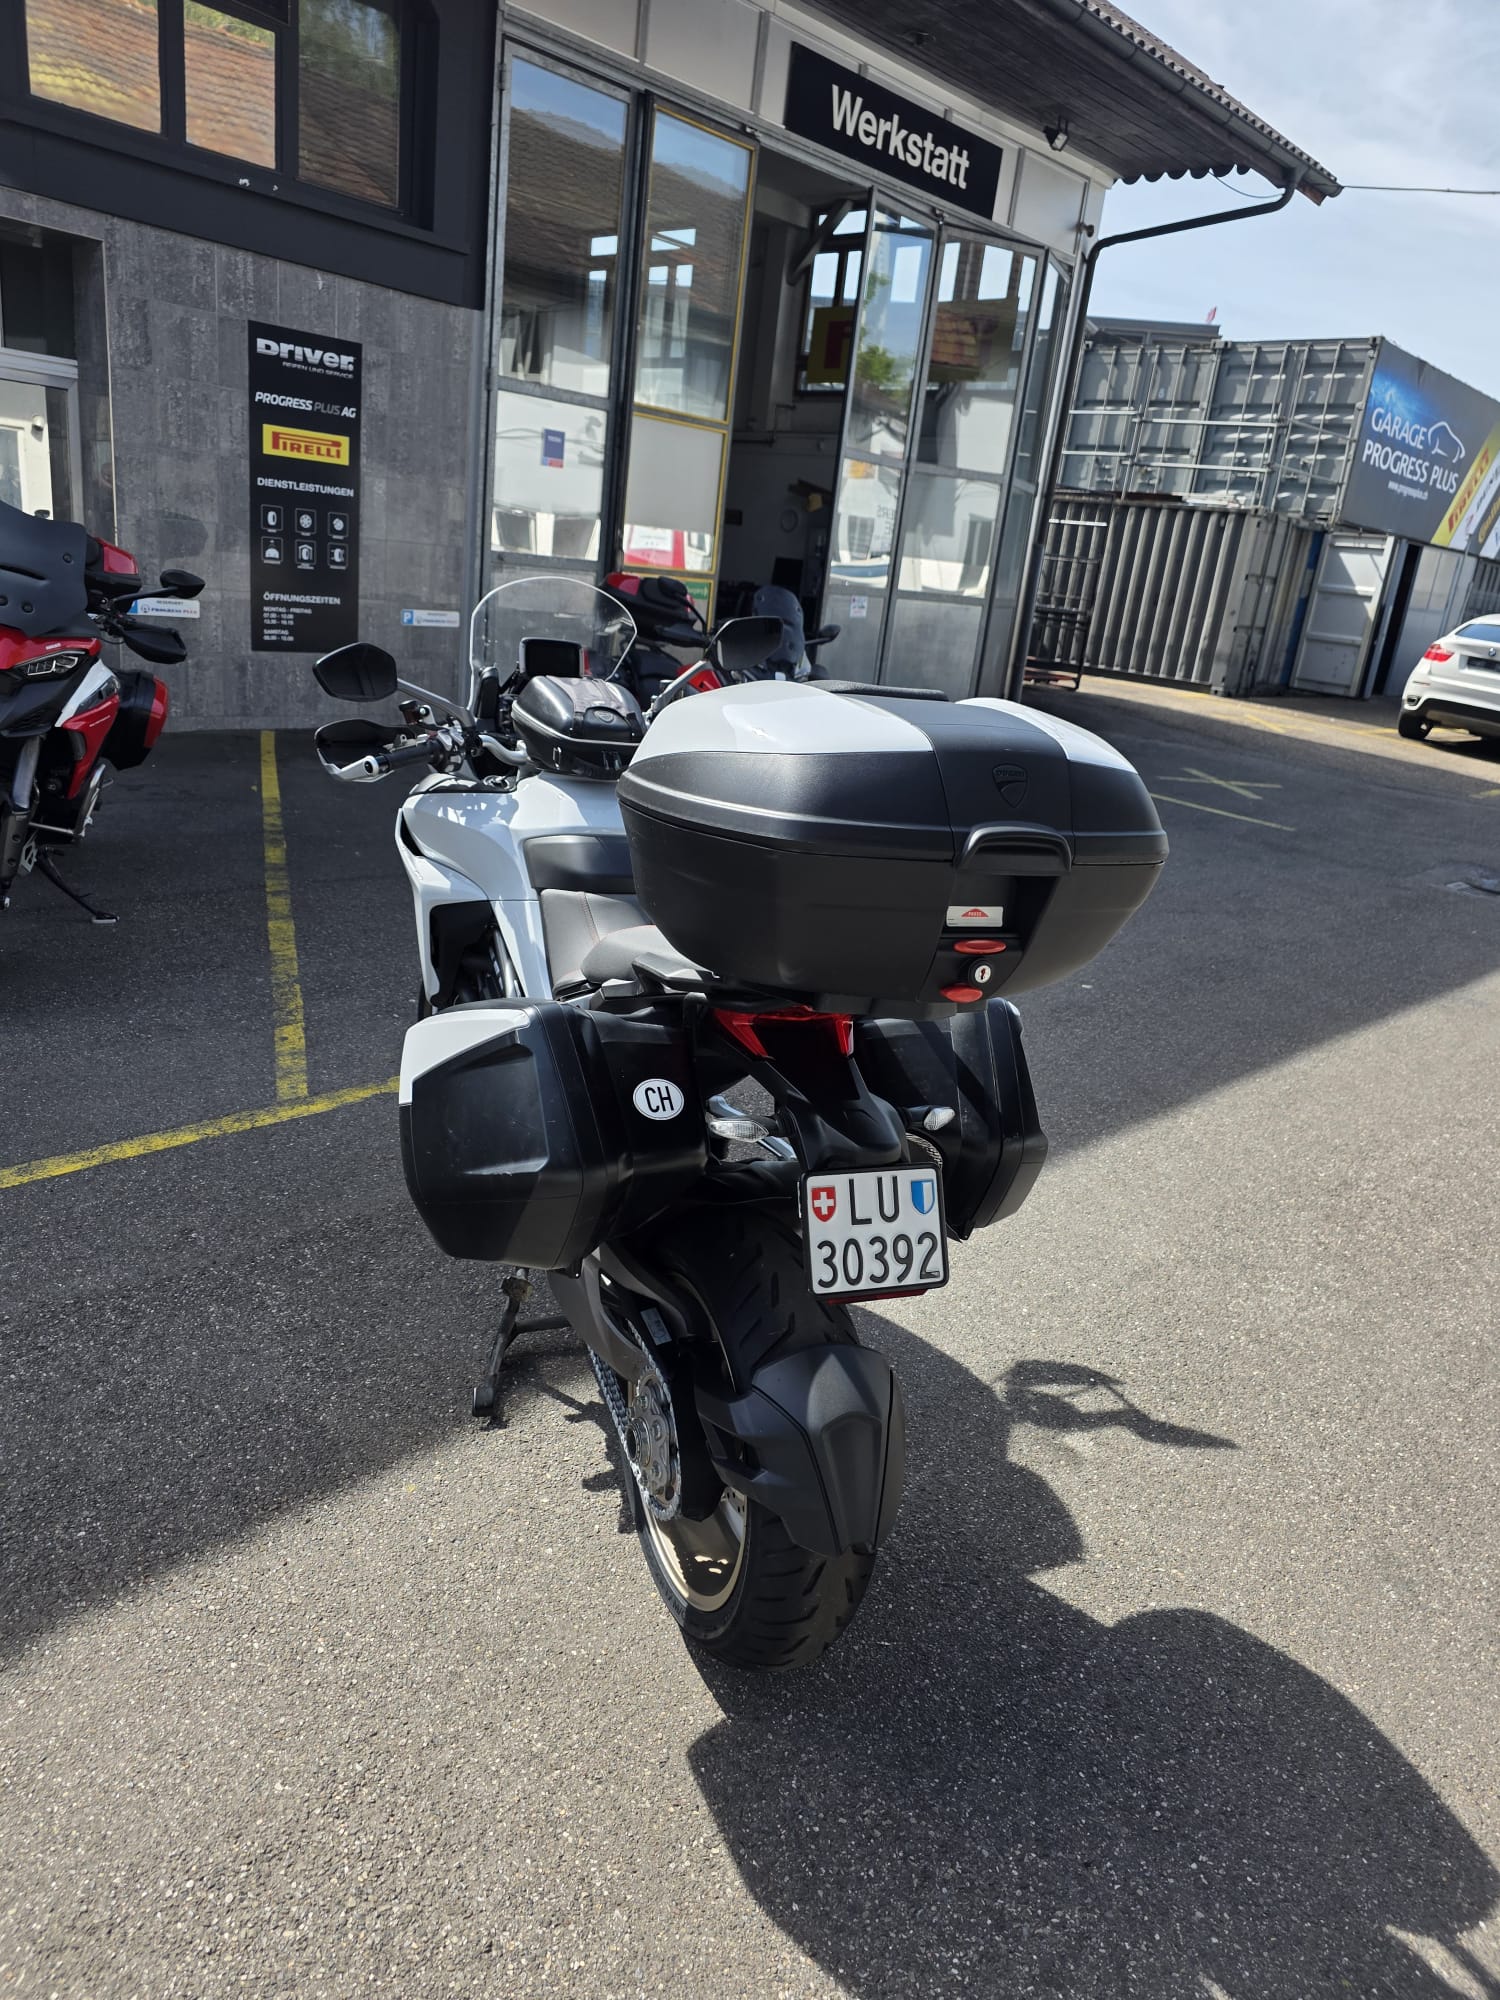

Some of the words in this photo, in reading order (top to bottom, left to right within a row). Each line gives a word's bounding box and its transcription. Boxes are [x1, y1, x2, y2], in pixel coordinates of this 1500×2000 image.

[832, 84, 970, 189] Werkstatt
[255, 391, 313, 411] PROGRESS
[314, 402, 341, 415] PLUS
[341, 406, 357, 418] AG
[1371, 407, 1428, 449] GARAGE
[272, 431, 342, 459] PIRELLI
[1362, 440, 1430, 483] PROGRESS
[1429, 465, 1459, 493] PLUS
[257, 477, 354, 497] DIENSTLEISTUNGEN
[263, 591, 341, 605] ÖFFNUNGSZEITEN
[403, 612, 411, 624] P
[644, 1086, 674, 1113] CH
[849, 1176, 900, 1225] LU
[817, 1232, 941, 1289] 30392
